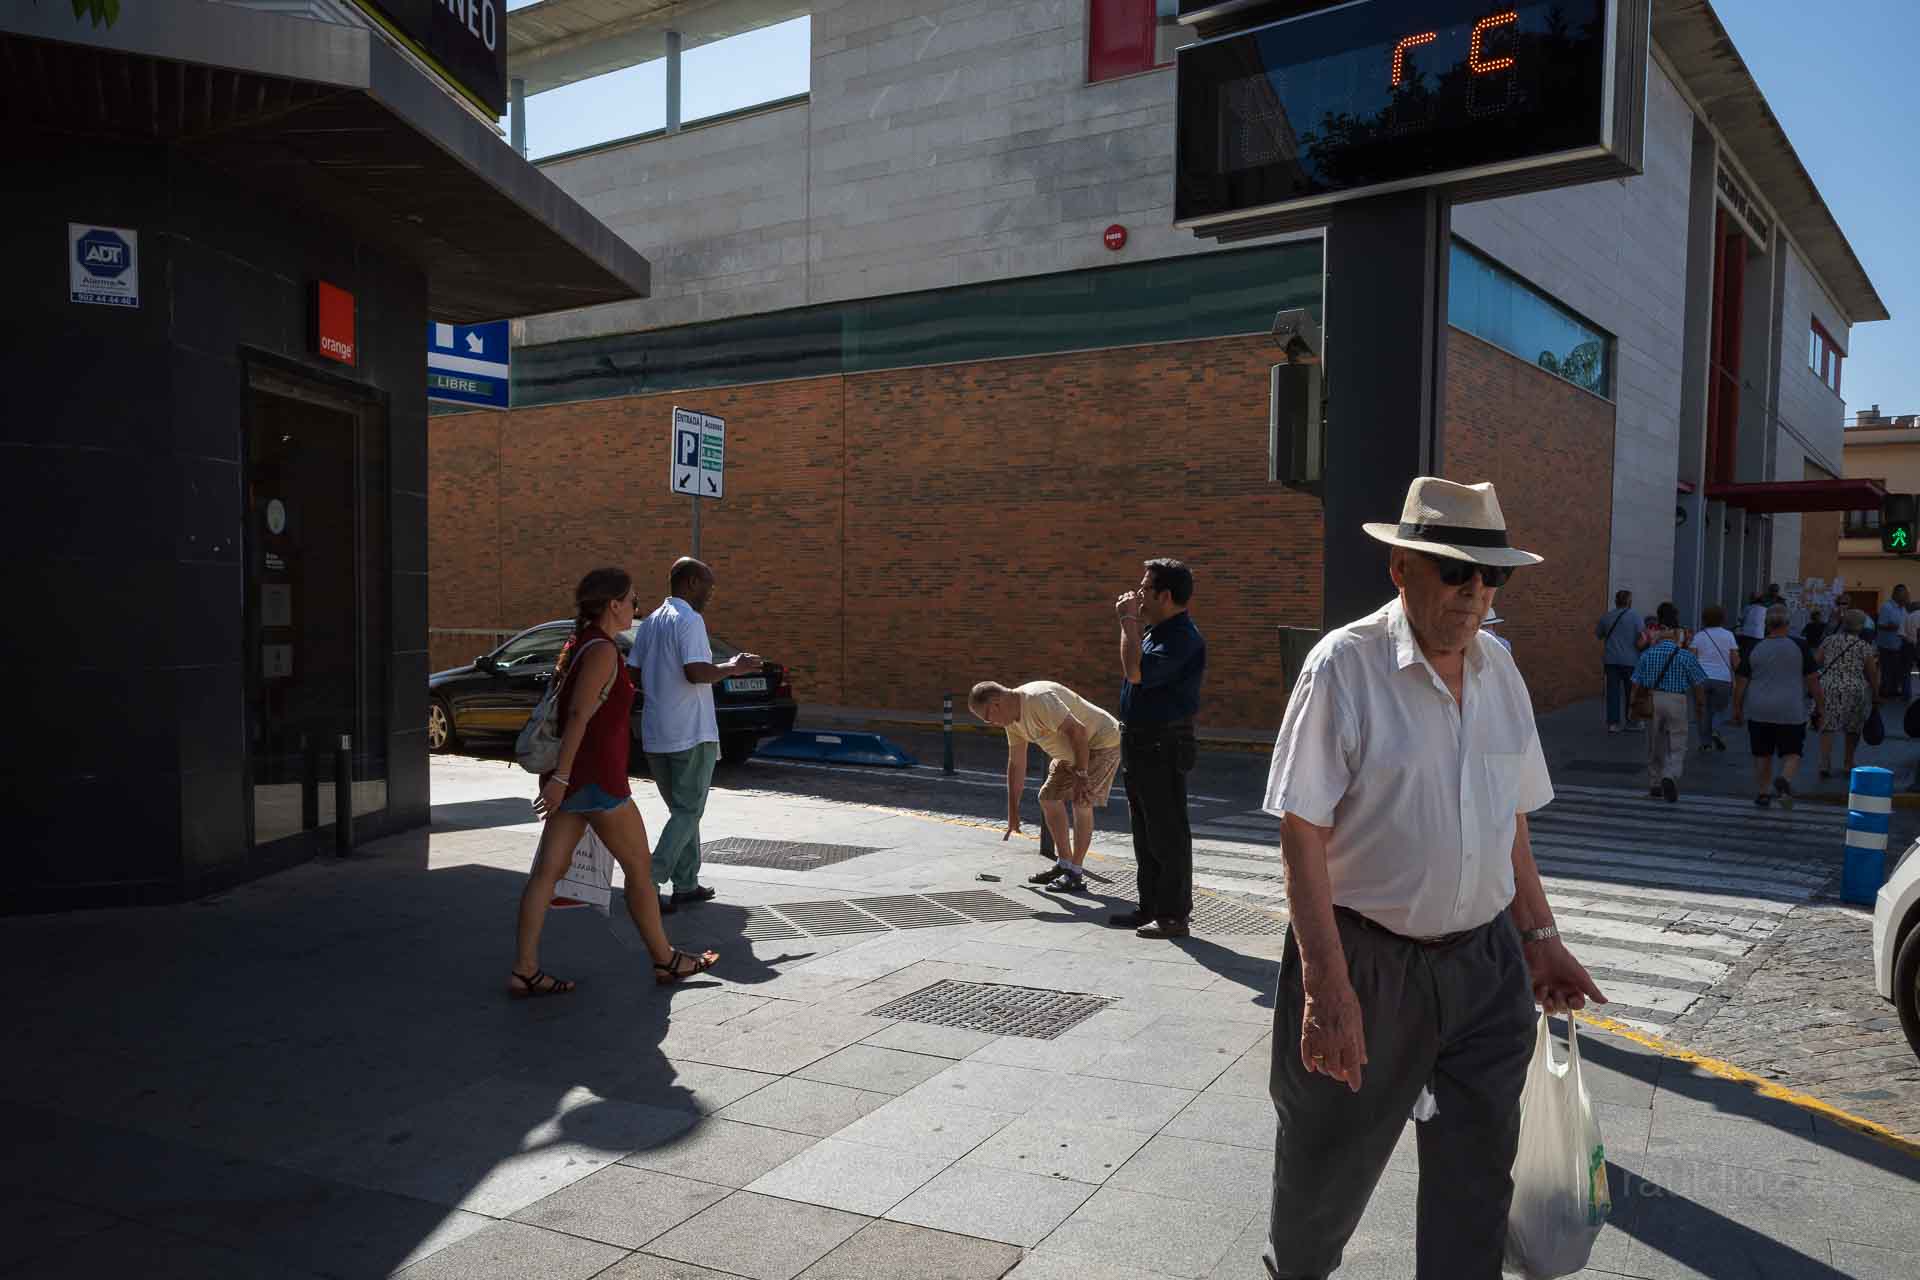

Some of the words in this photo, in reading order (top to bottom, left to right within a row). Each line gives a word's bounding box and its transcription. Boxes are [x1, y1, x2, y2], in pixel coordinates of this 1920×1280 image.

[86, 244, 122, 263] ADT
[321, 336, 353, 359] orange
[438, 376, 478, 392] LIBRE
[677, 412, 700, 426] ENTRADA
[681, 432, 695, 465] P
